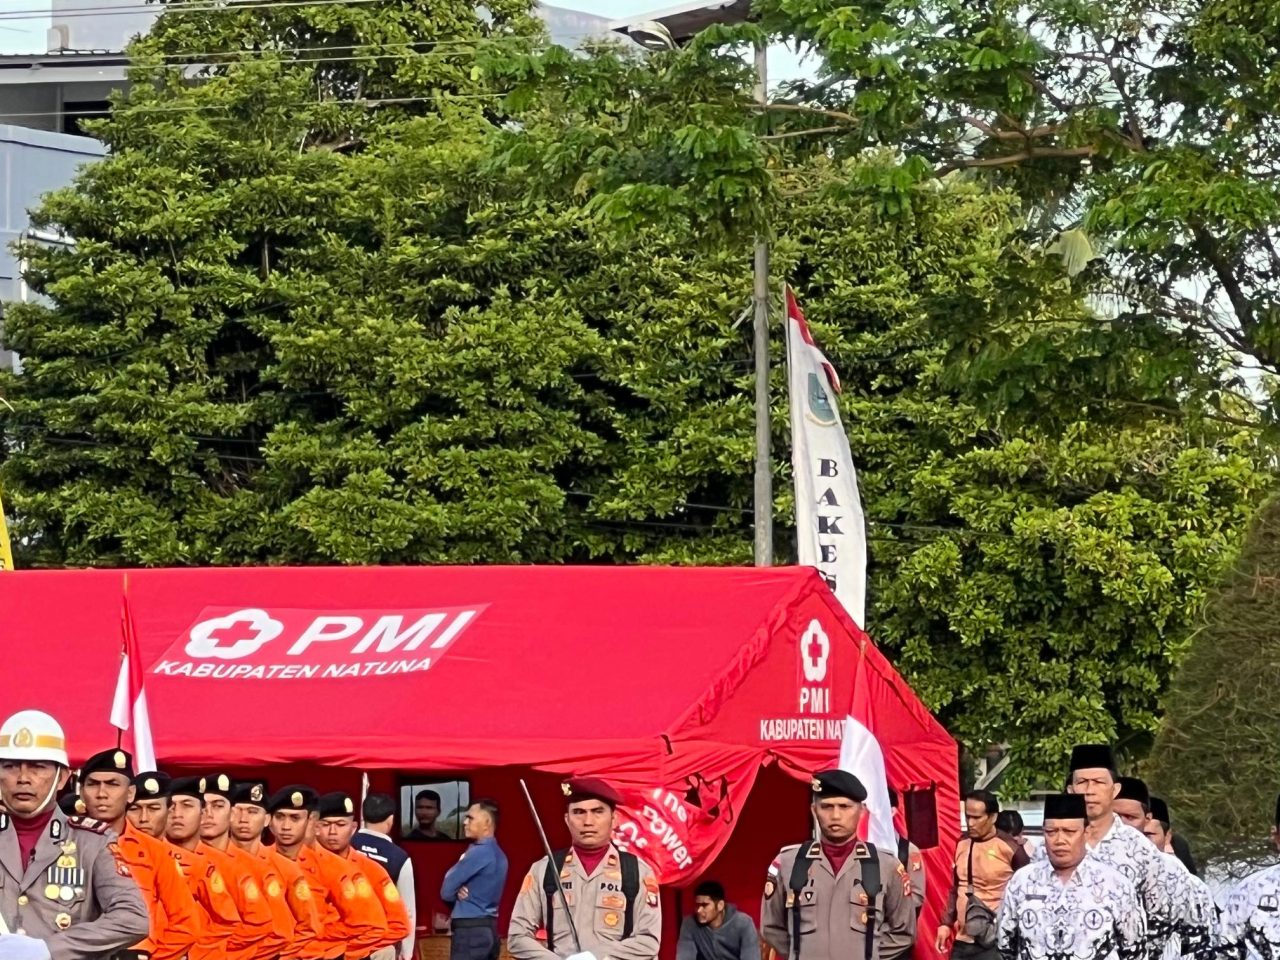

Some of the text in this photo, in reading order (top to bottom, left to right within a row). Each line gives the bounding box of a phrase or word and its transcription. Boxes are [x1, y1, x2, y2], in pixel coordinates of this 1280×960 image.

[287, 610, 477, 656] PMI
[153, 656, 432, 680] KABUPATEN NATUNA
[799, 686, 830, 714] PMI
[760, 718, 825, 741] KABUPATEN
